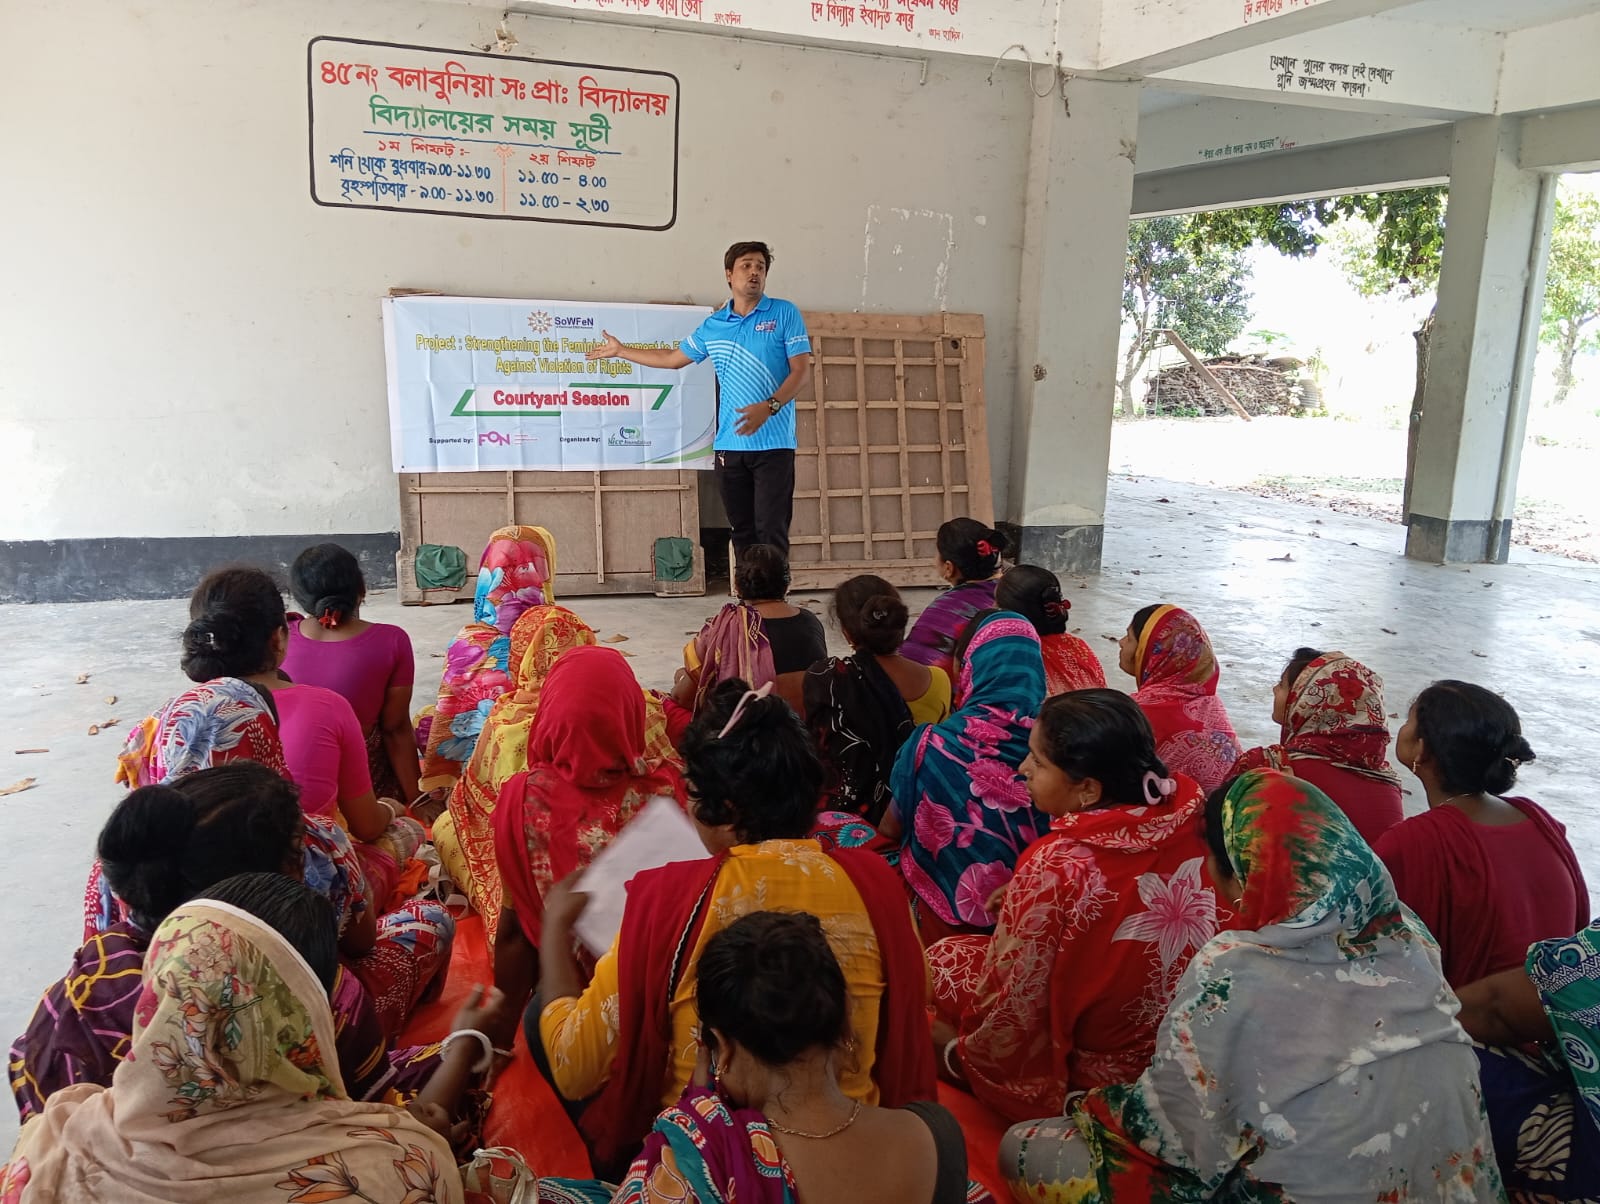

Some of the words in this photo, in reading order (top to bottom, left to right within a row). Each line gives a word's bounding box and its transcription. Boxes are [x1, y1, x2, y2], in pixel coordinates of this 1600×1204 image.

[811, 2, 823, 22] সে
[859, 4, 892, 30] ইবাদত
[385, 61, 495, 105] বলাবুনিয়া
[500, 77, 526, 100] সঃ
[531, 79, 569, 104] প্রাঃ
[578, 75, 670, 116] বিদ্যালয়
[369, 95, 494, 135] বিদ্যালয়ের
[502, 116, 557, 141] সময়
[568, 113, 612, 154] সূচী
[330, 148, 355, 172] শনি
[358, 156, 386, 176] থেকে
[341, 173, 408, 202] বৃহস্পতিবার
[554, 316, 594, 326] SoWFeN
[416, 334, 456, 353] Project
[464, 335, 540, 356] Strengthening
[543, 338, 560, 353] the
[496, 357, 537, 376] Against
[539, 358, 585, 375] Violation
[587, 359, 598, 375] of
[600, 359, 633, 378] Rights
[493, 390, 568, 408] Courtyard
[572, 391, 630, 406] Session
[478, 431, 511, 446] FON
